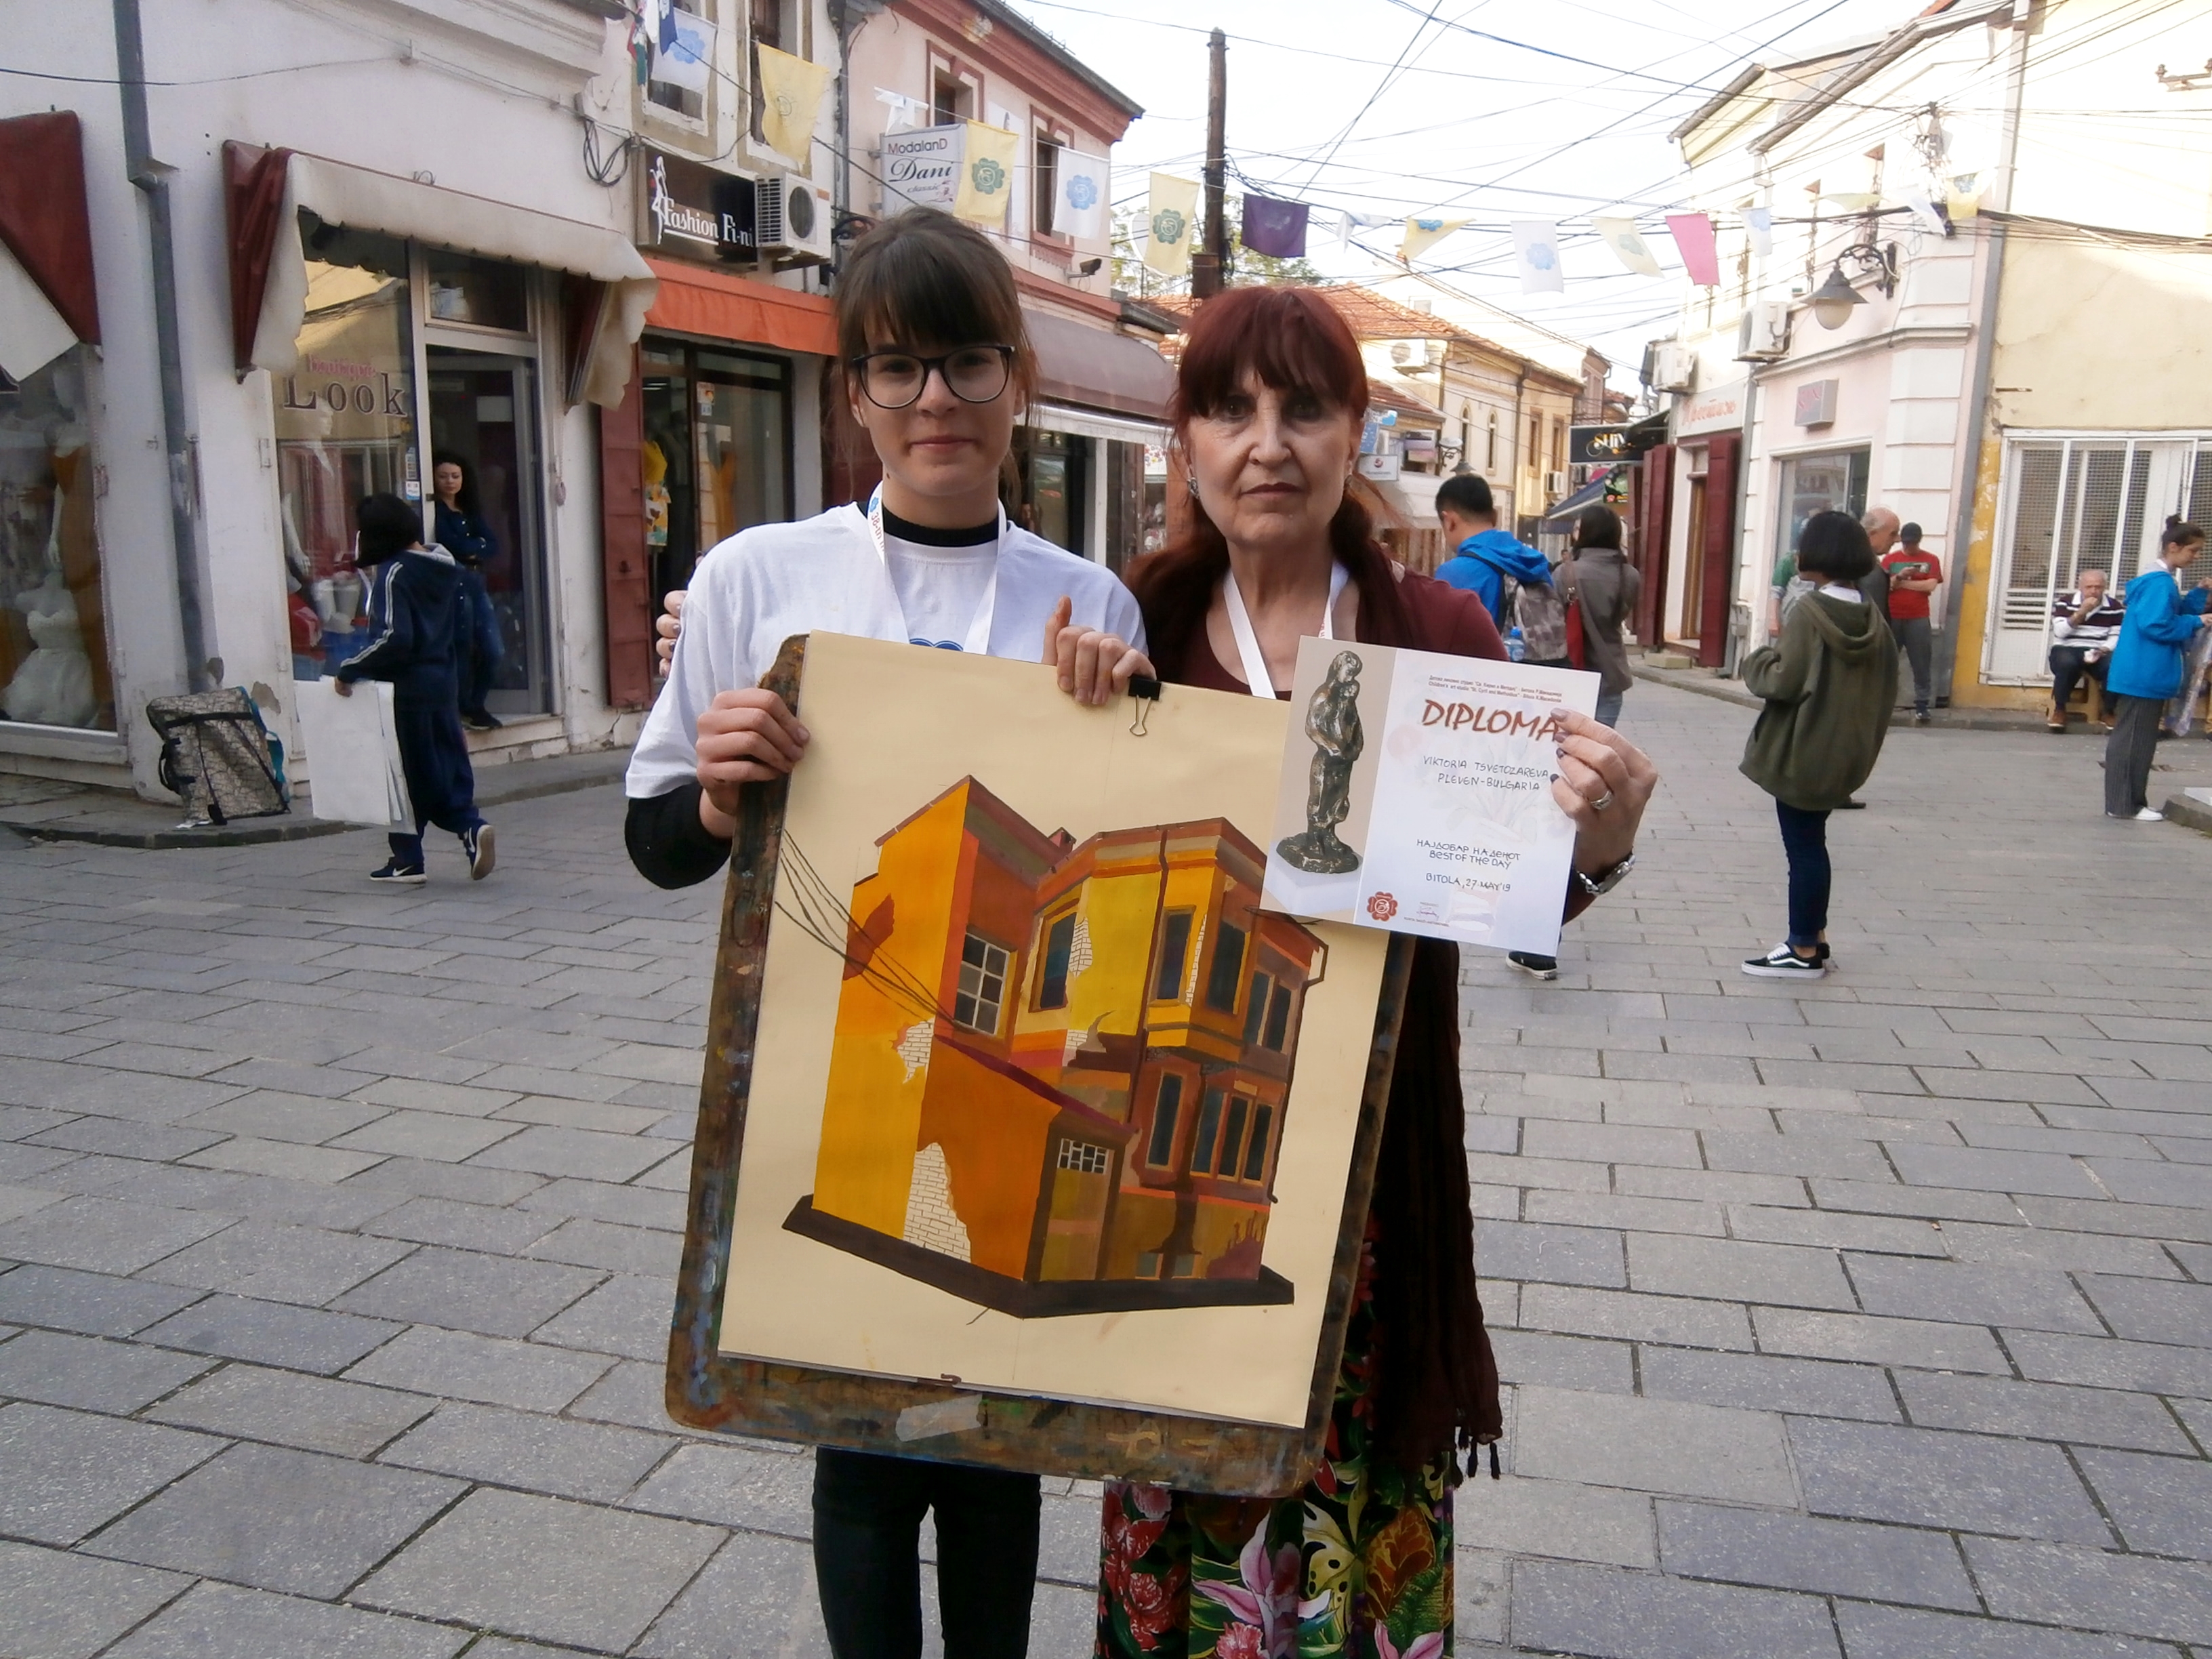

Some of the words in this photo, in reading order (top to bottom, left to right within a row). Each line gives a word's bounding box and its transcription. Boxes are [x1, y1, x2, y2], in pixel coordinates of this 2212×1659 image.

[888, 138, 948, 155] ModalanD
[888, 157, 953, 182] Dani
[907, 182, 941, 194] classic
[663, 197, 720, 239] Fashion
[283, 371, 407, 417] Look
[871, 512, 882, 540] 38-th
[1422, 699, 1559, 741] DIPLOMA
[1423, 755, 1467, 769] VIKTORIA
[1474, 762, 1549, 778] TSVETOZAREVA
[1437, 773, 1540, 792] PLEVEN-BULGARIA
[1455, 854, 1467, 862] OF
[1492, 858, 1512, 870] DAY
